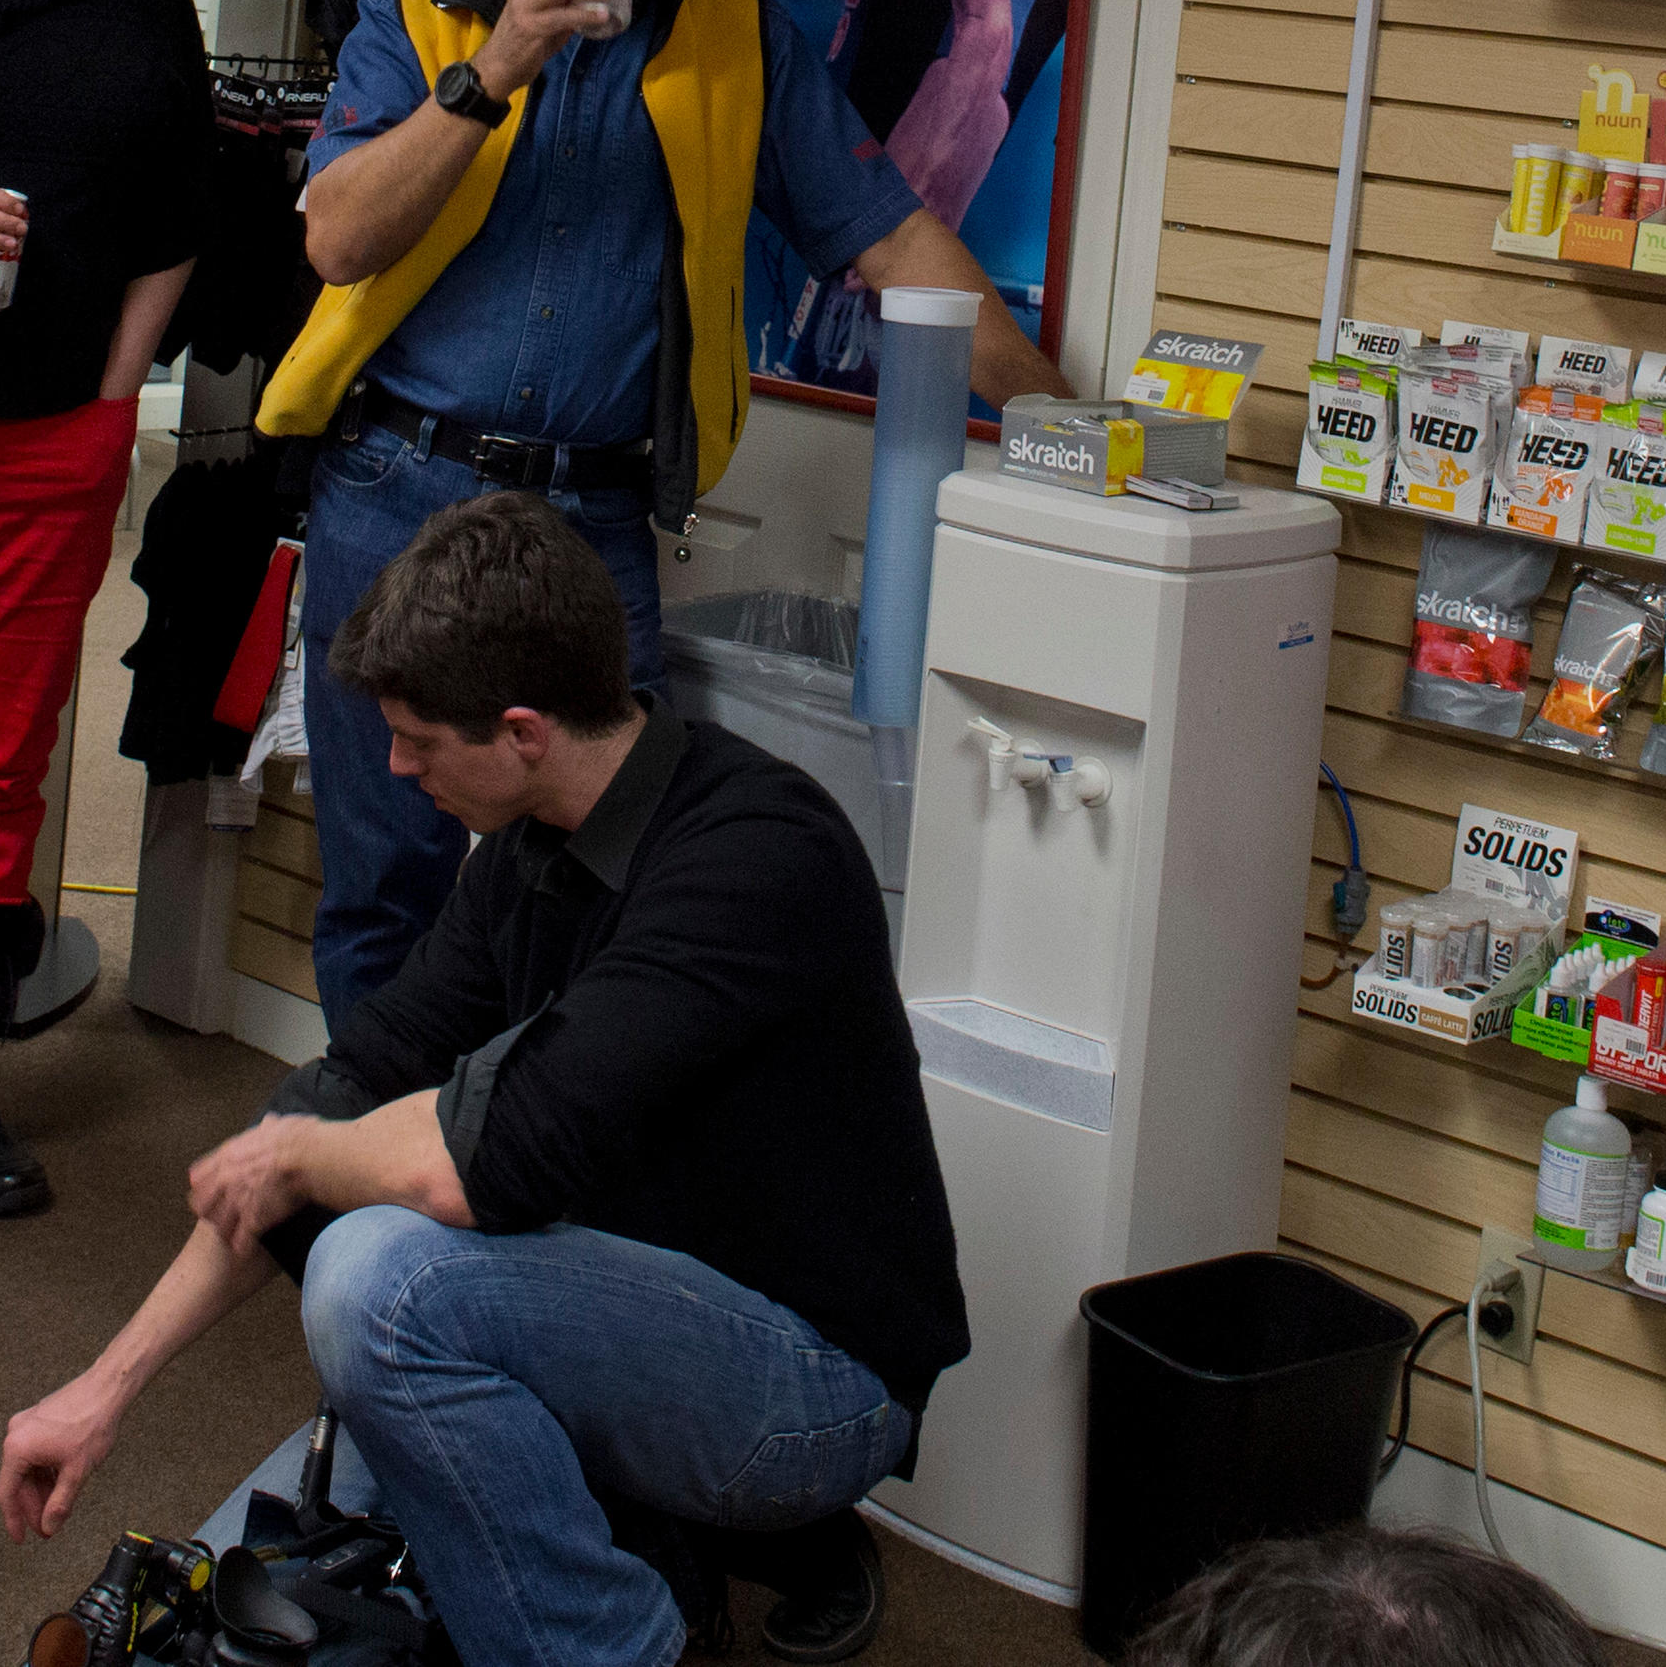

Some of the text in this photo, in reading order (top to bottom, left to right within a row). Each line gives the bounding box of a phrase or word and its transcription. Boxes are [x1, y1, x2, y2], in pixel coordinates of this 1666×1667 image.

[1595, 113, 1642, 129] nuun
[1574, 220, 1624, 241] nuun
[1154, 336, 1244, 366] skratch
[1358, 334, 1401, 356] HEED
[1559, 350, 1607, 374] HEED
[1317, 404, 1376, 443] HEED
[1409, 412, 1478, 453] HEED
[1008, 434, 1094, 475] skratch
[1517, 432, 1589, 470] HEED
[1417, 591, 1509, 632] skratch
[1463, 825, 1568, 878] SOLIDS
[1385, 933, 1405, 981] LIDS
[1354, 989, 1419, 1025] SOLIDS
[1444, 1016, 1465, 1034] LATTE
